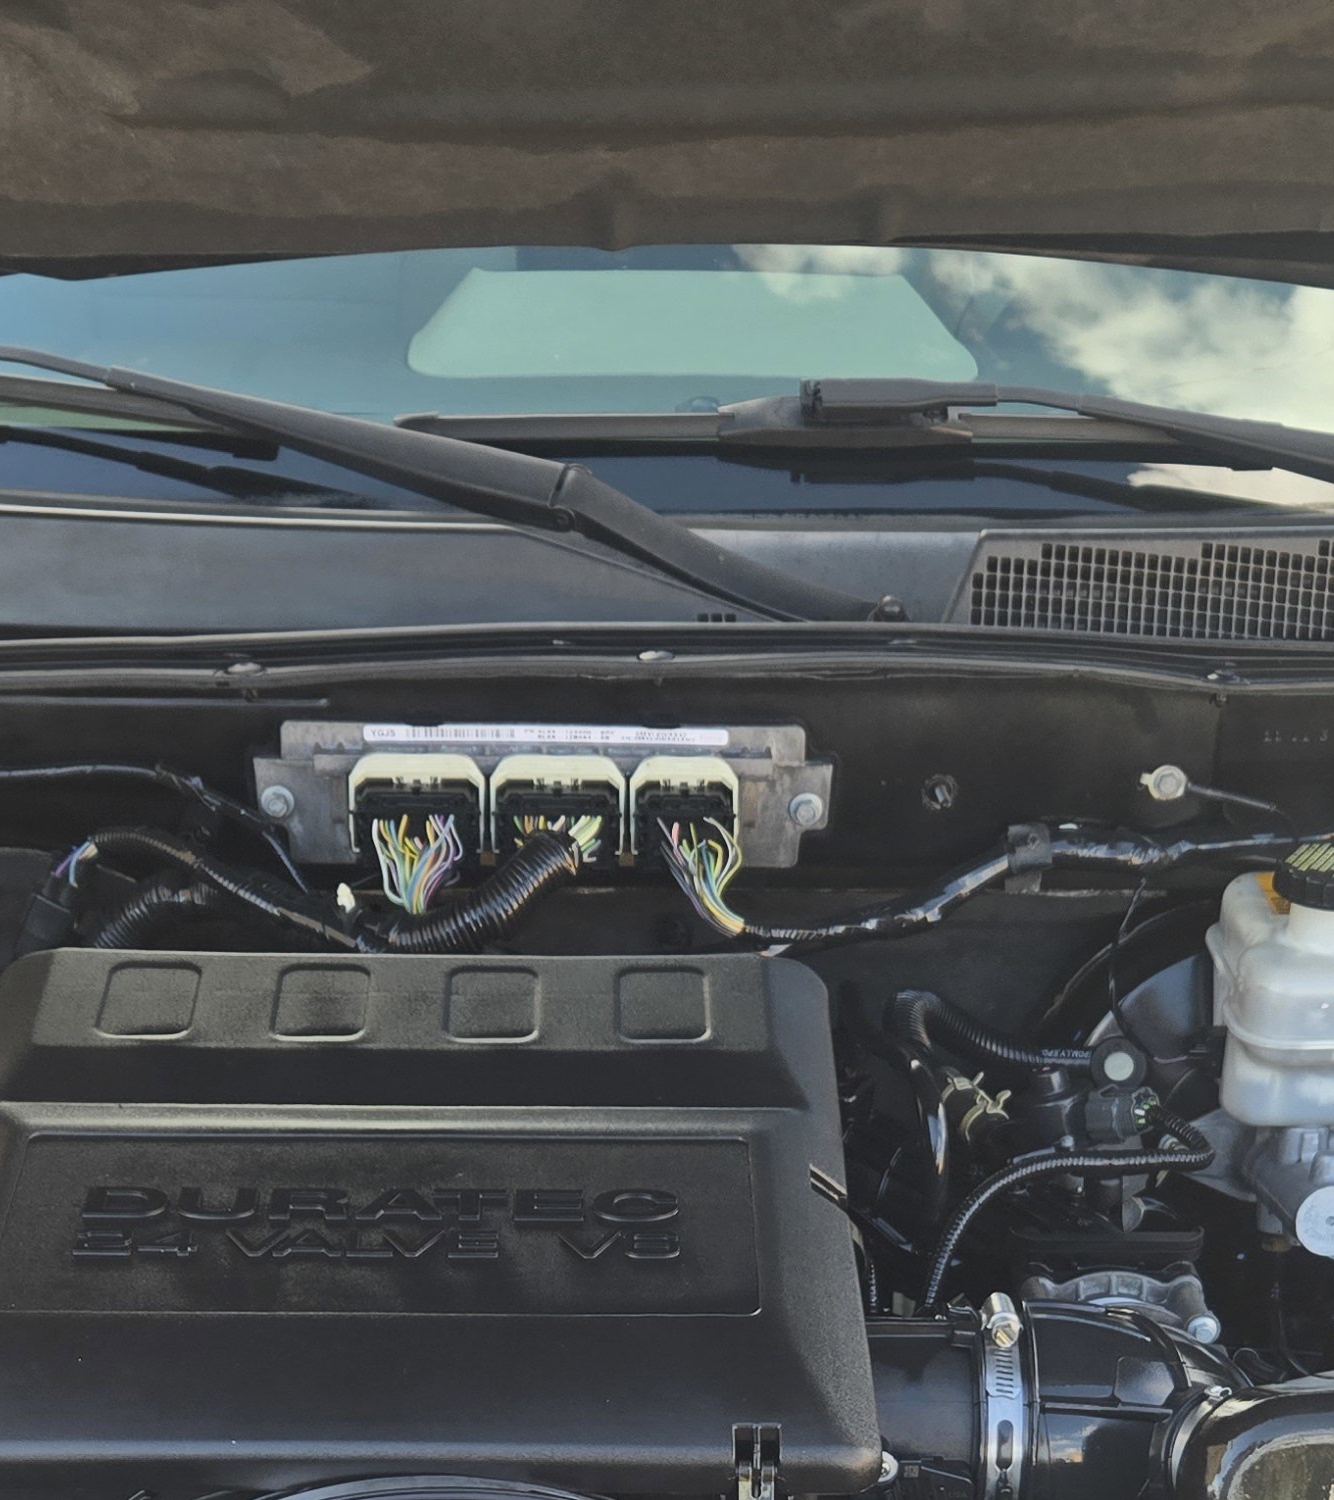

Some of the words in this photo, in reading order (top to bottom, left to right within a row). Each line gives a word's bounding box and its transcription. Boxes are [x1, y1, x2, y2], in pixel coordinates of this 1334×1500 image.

[78, 1185, 681, 1223] DURATEC
[71, 1228, 198, 1259] 24
[224, 1228, 500, 1260] VALVE
